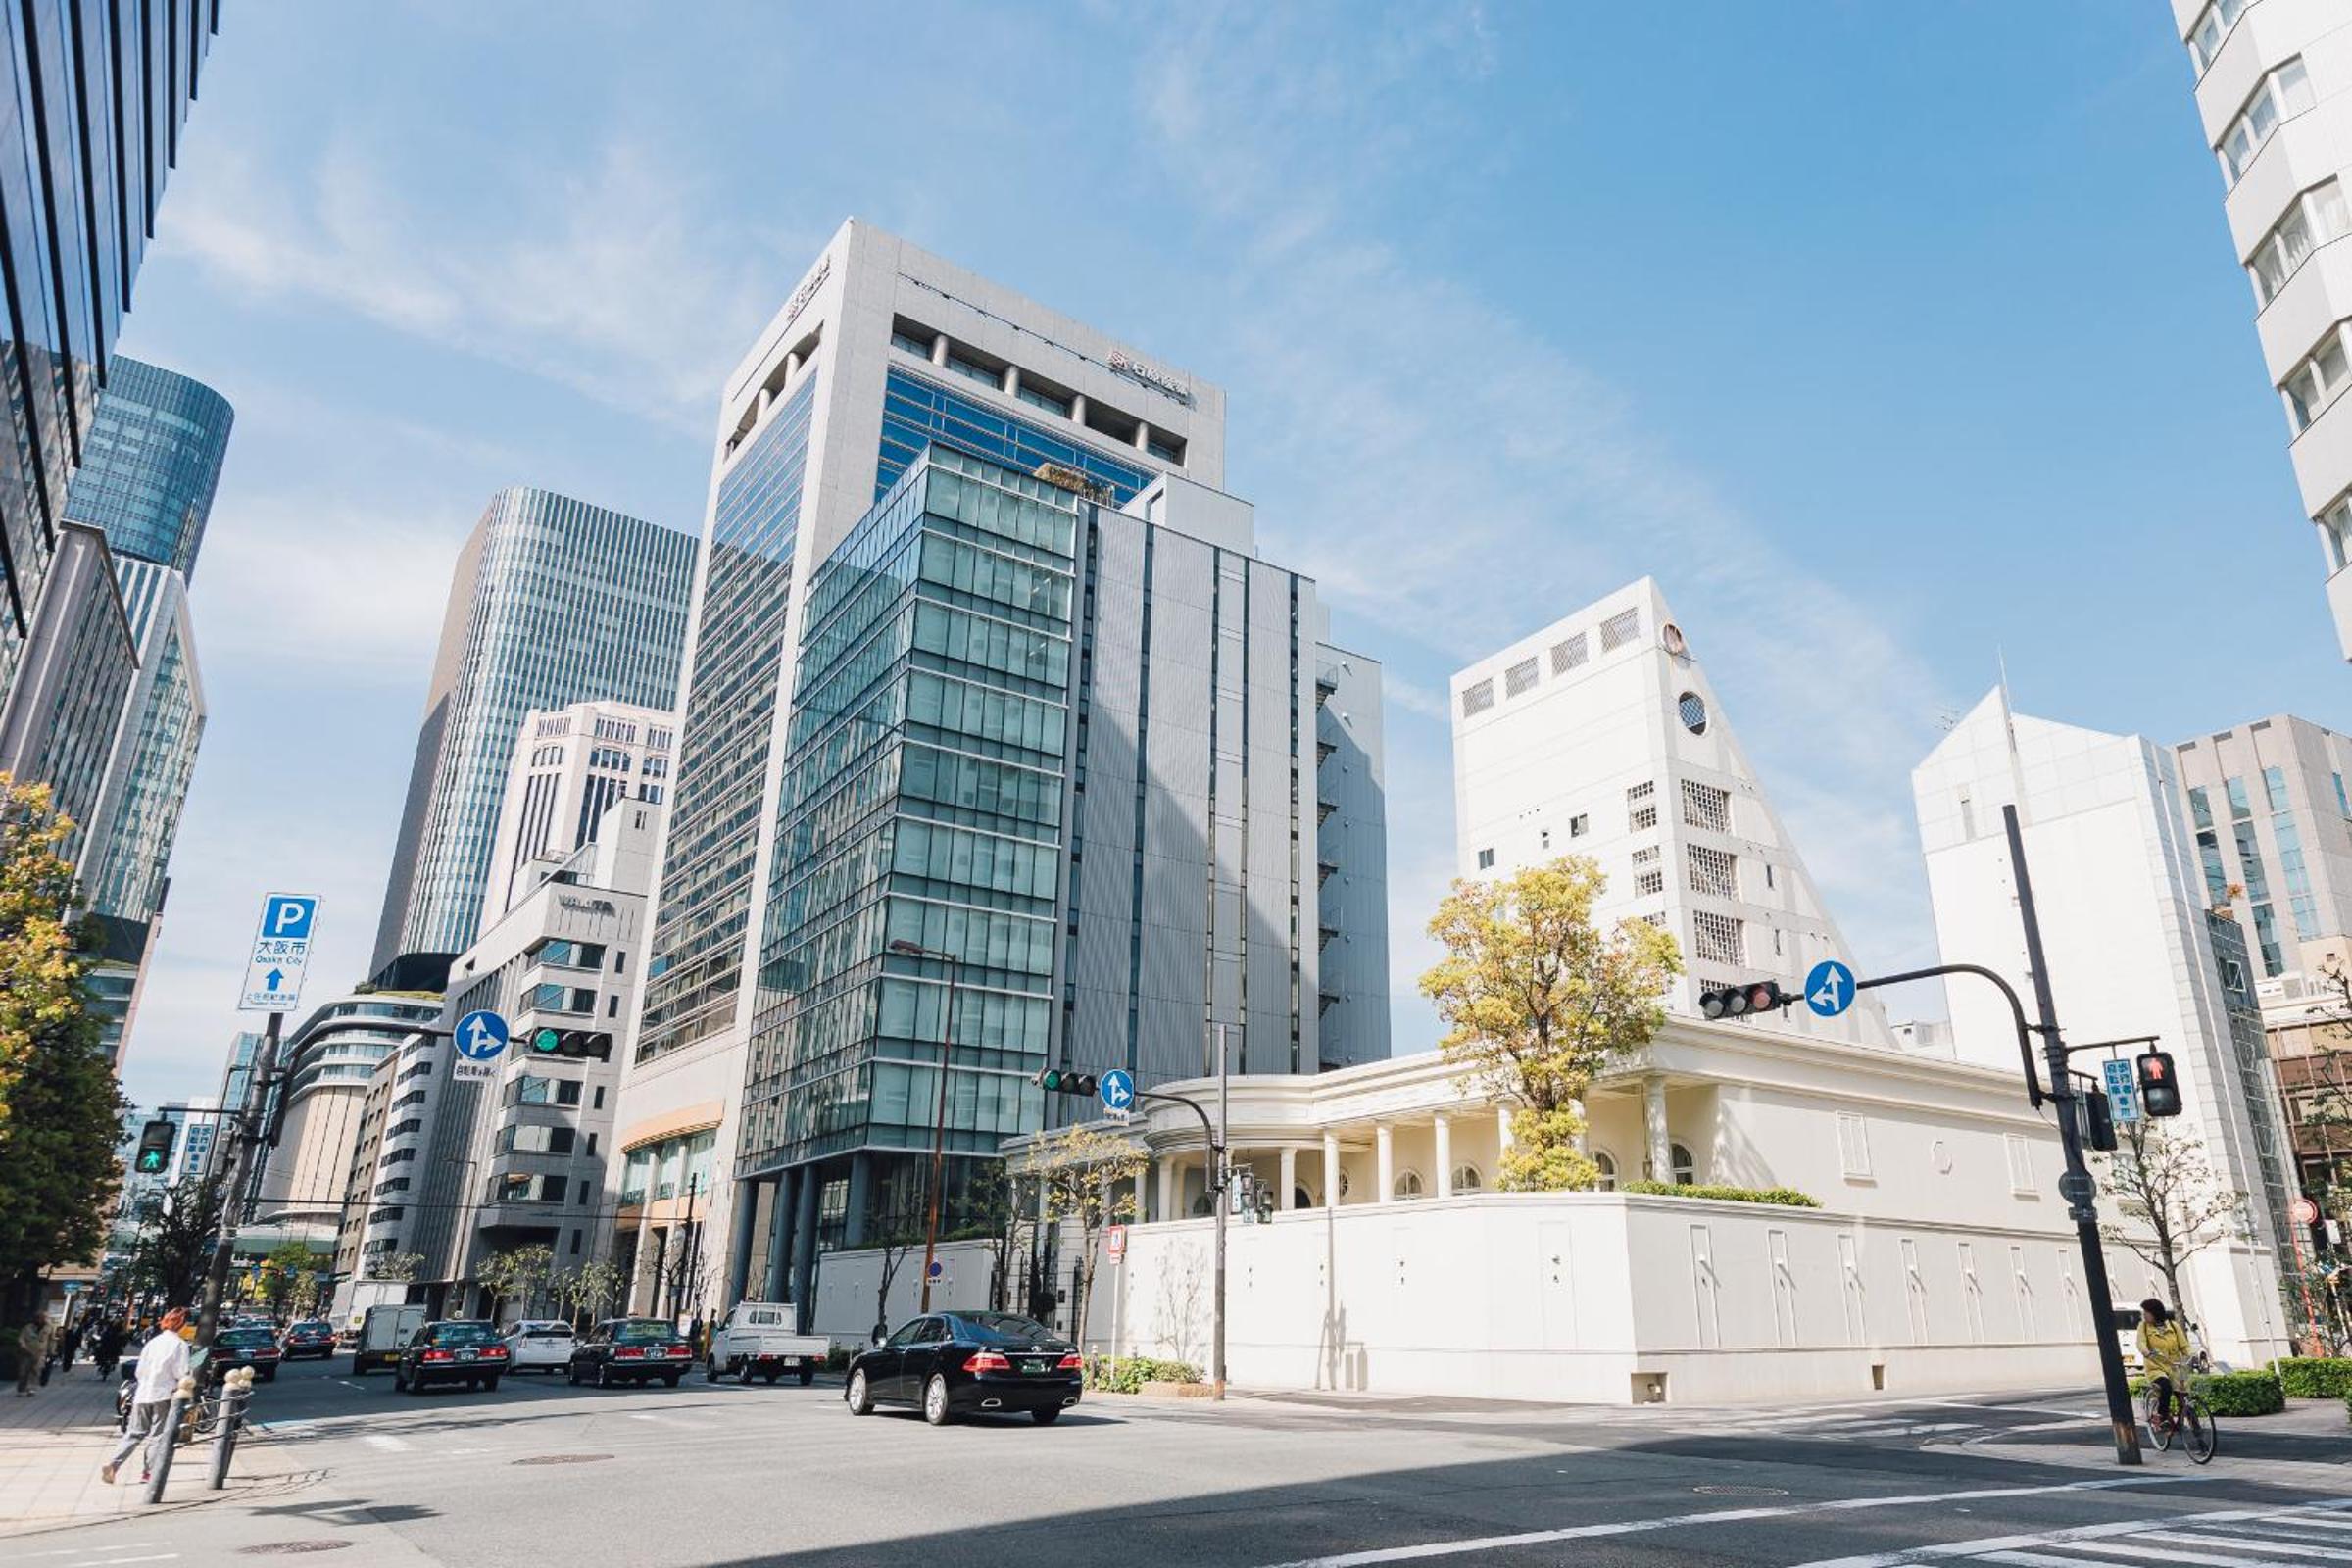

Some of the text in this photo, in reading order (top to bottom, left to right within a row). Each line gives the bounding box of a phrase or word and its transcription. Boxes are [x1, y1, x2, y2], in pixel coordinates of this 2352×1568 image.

[275, 903, 305, 933] P
[257, 941, 307, 955] 大阪市
[255, 955, 303, 966] Osaka City
